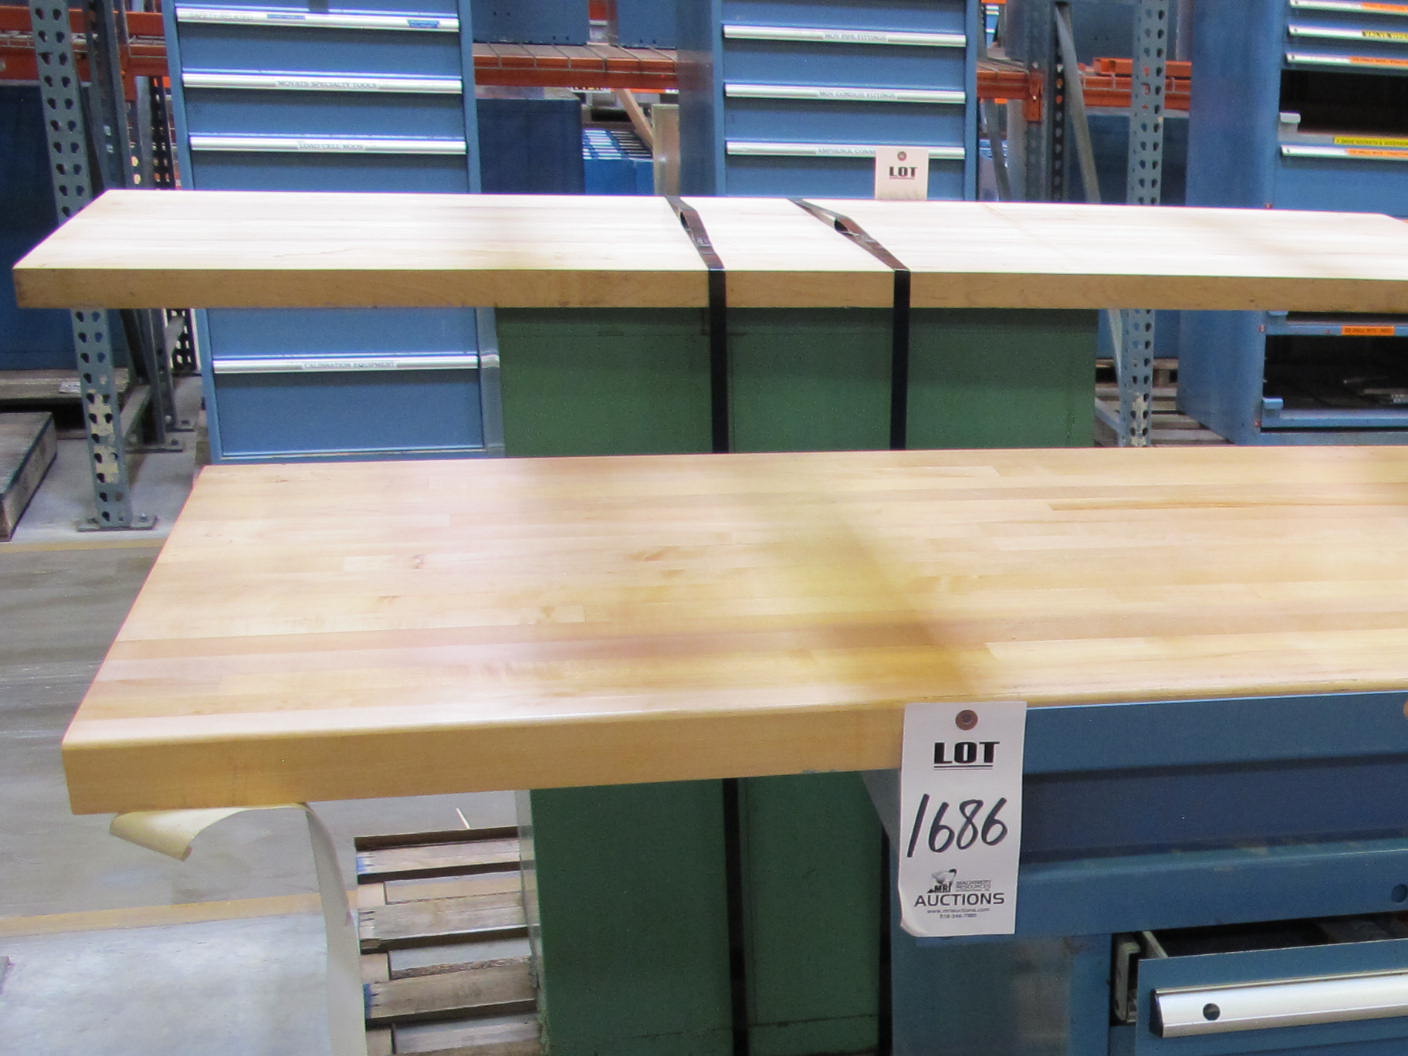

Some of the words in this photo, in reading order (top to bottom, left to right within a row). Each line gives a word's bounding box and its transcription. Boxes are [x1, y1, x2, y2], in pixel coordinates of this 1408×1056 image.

[889, 166, 918, 177] LOT
[934, 741, 1000, 764] LOT
[907, 793, 1008, 858] 1686
[914, 893, 1005, 907] AUCTIONS
